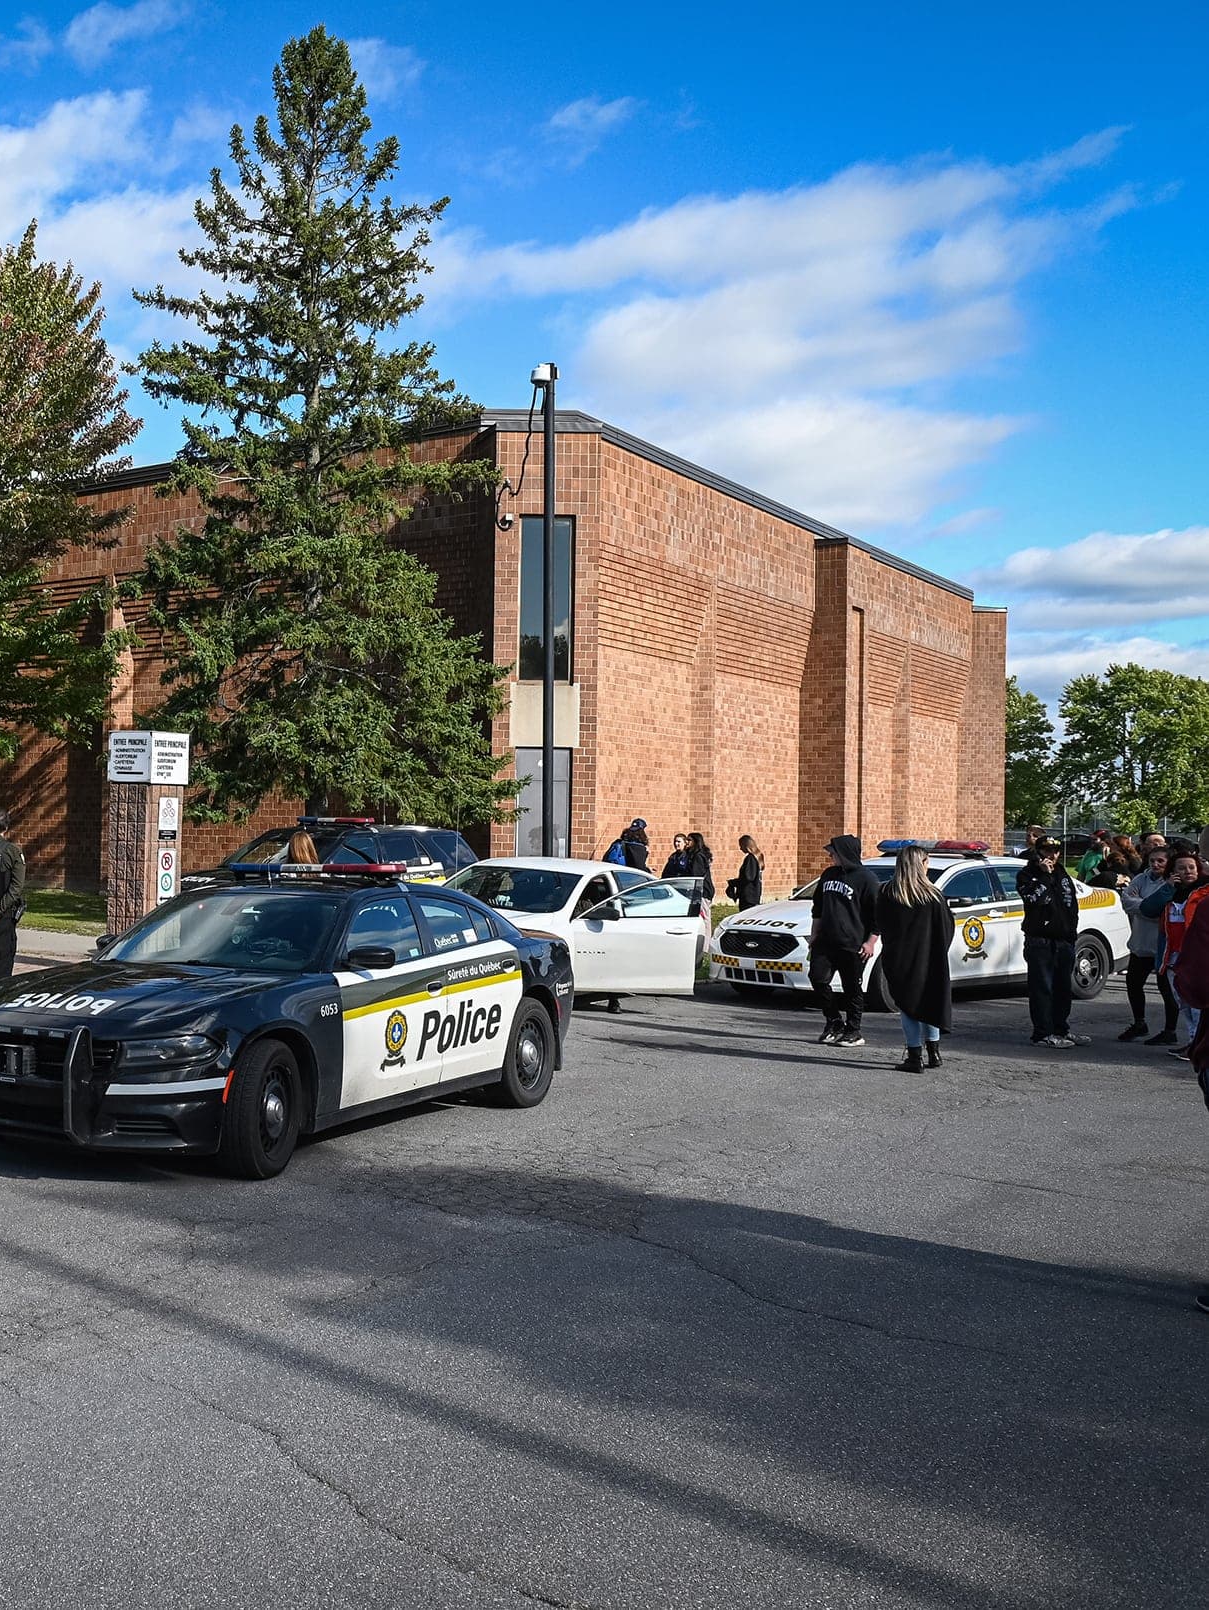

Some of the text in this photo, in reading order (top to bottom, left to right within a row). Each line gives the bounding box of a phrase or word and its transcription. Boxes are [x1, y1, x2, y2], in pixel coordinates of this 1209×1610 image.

[434, 935, 452, 948] Québec
[447, 961, 501, 981] Sûreté du Québec
[320, 1003, 339, 1018] 6053
[416, 999, 502, 1062] Police
